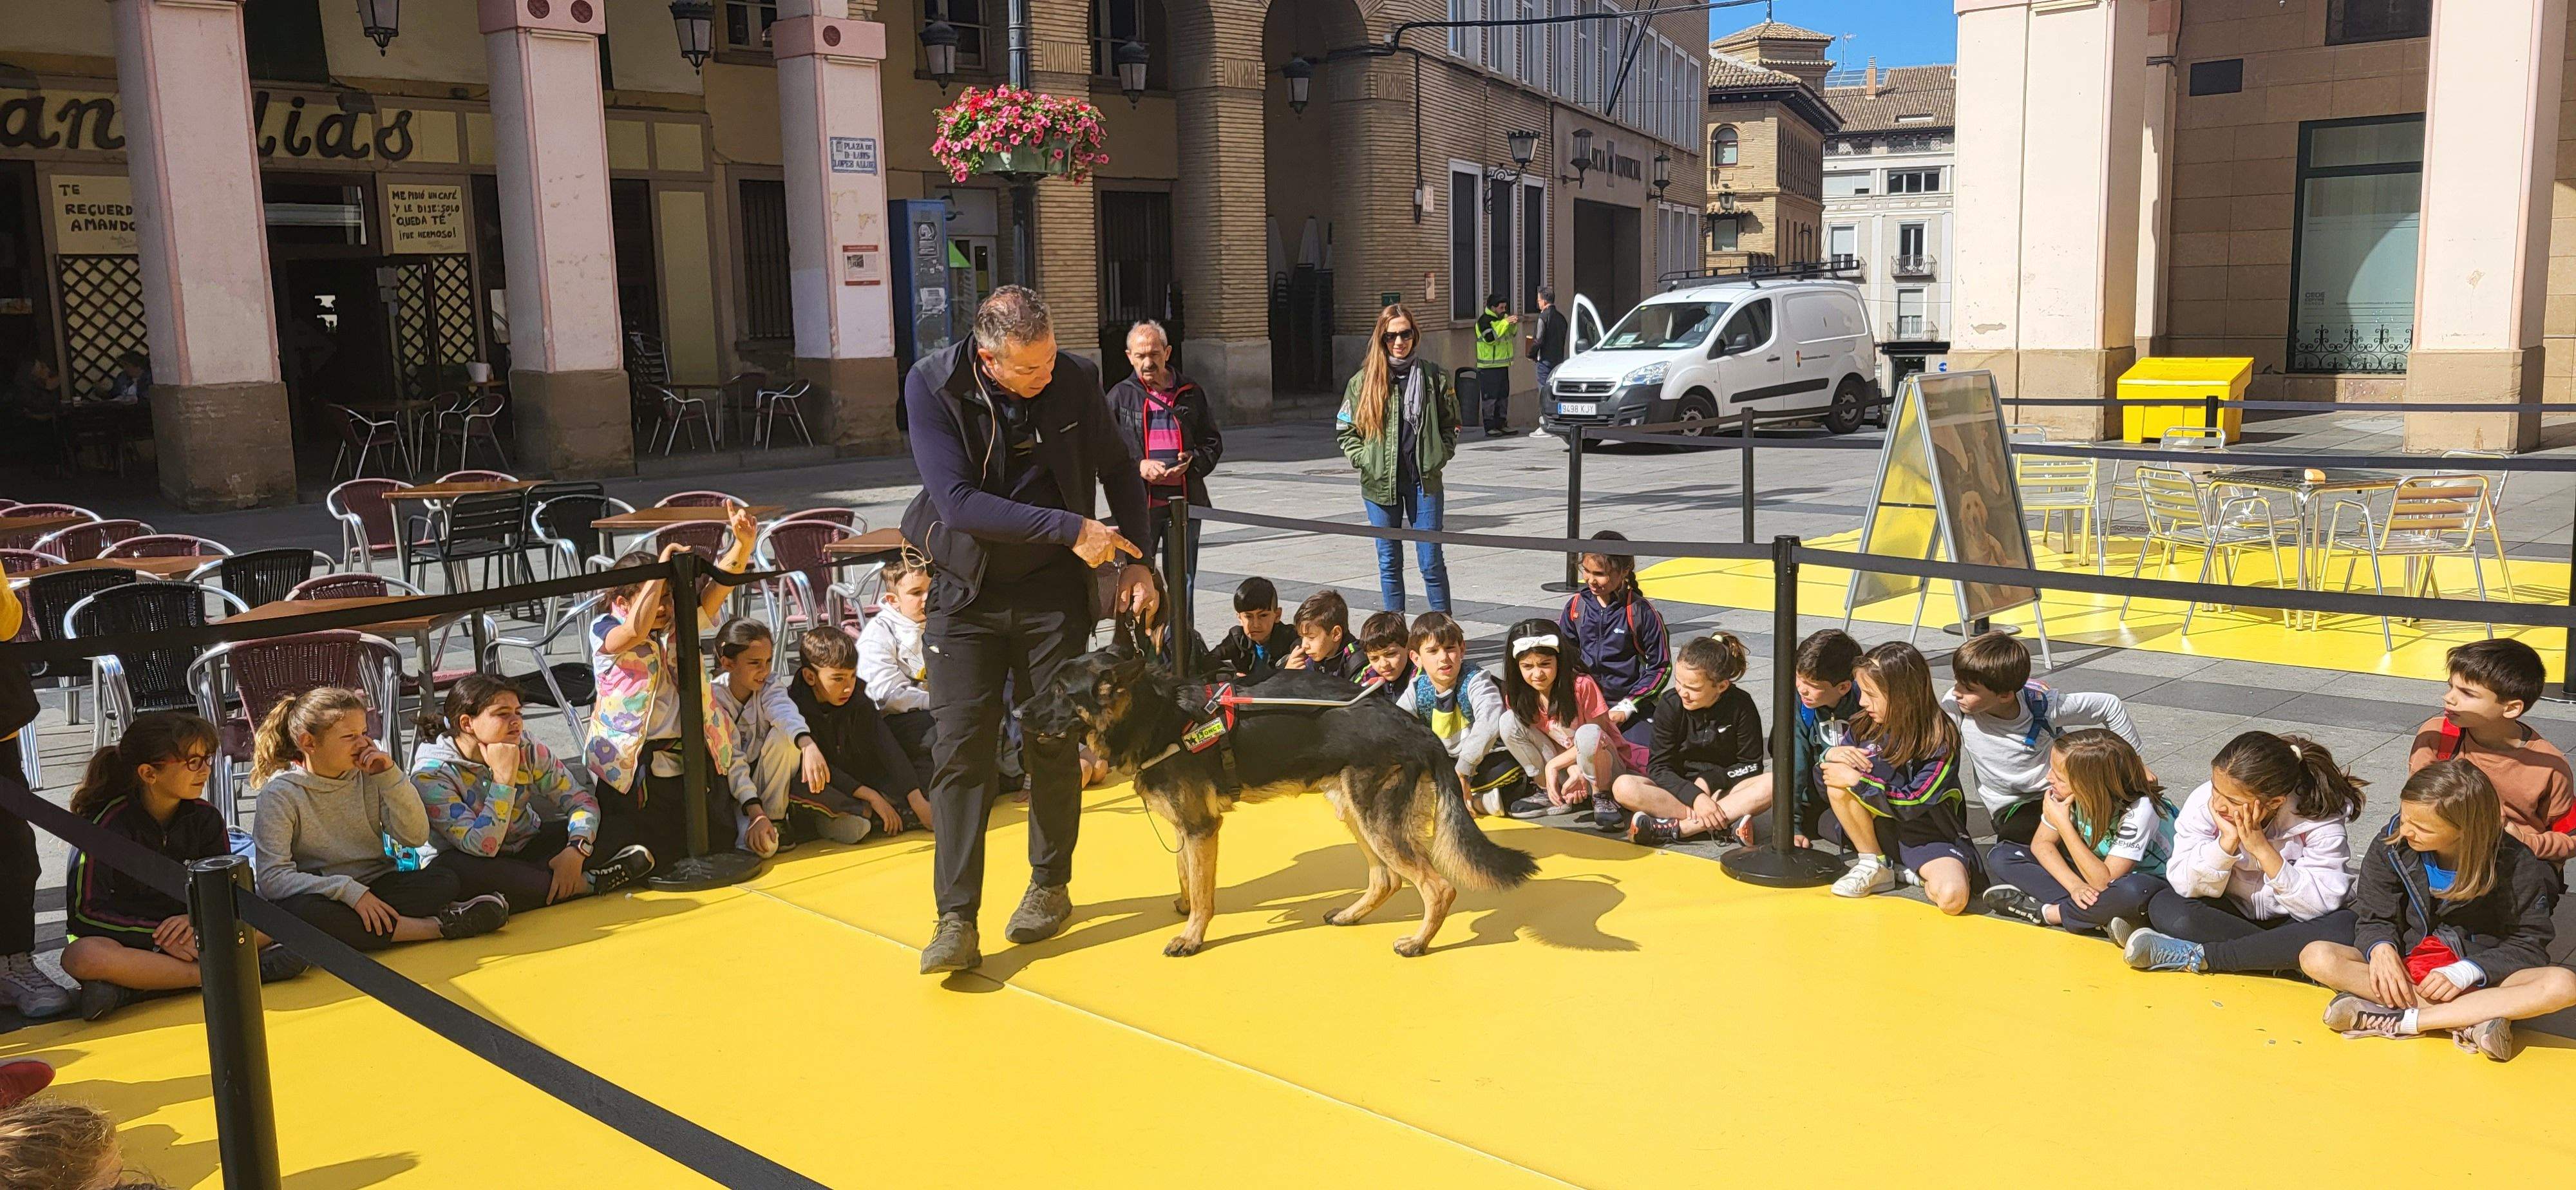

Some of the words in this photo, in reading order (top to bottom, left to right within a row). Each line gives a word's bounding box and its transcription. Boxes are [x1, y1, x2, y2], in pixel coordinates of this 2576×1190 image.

[58, 184, 80, 196] TE
[392, 191, 406, 200] ME
[393, 203, 400, 213] Y
[404, 203, 413, 212] LE
[417, 227, 457, 238] HERMOSO!
[1562, 404, 1578, 413] 9498
